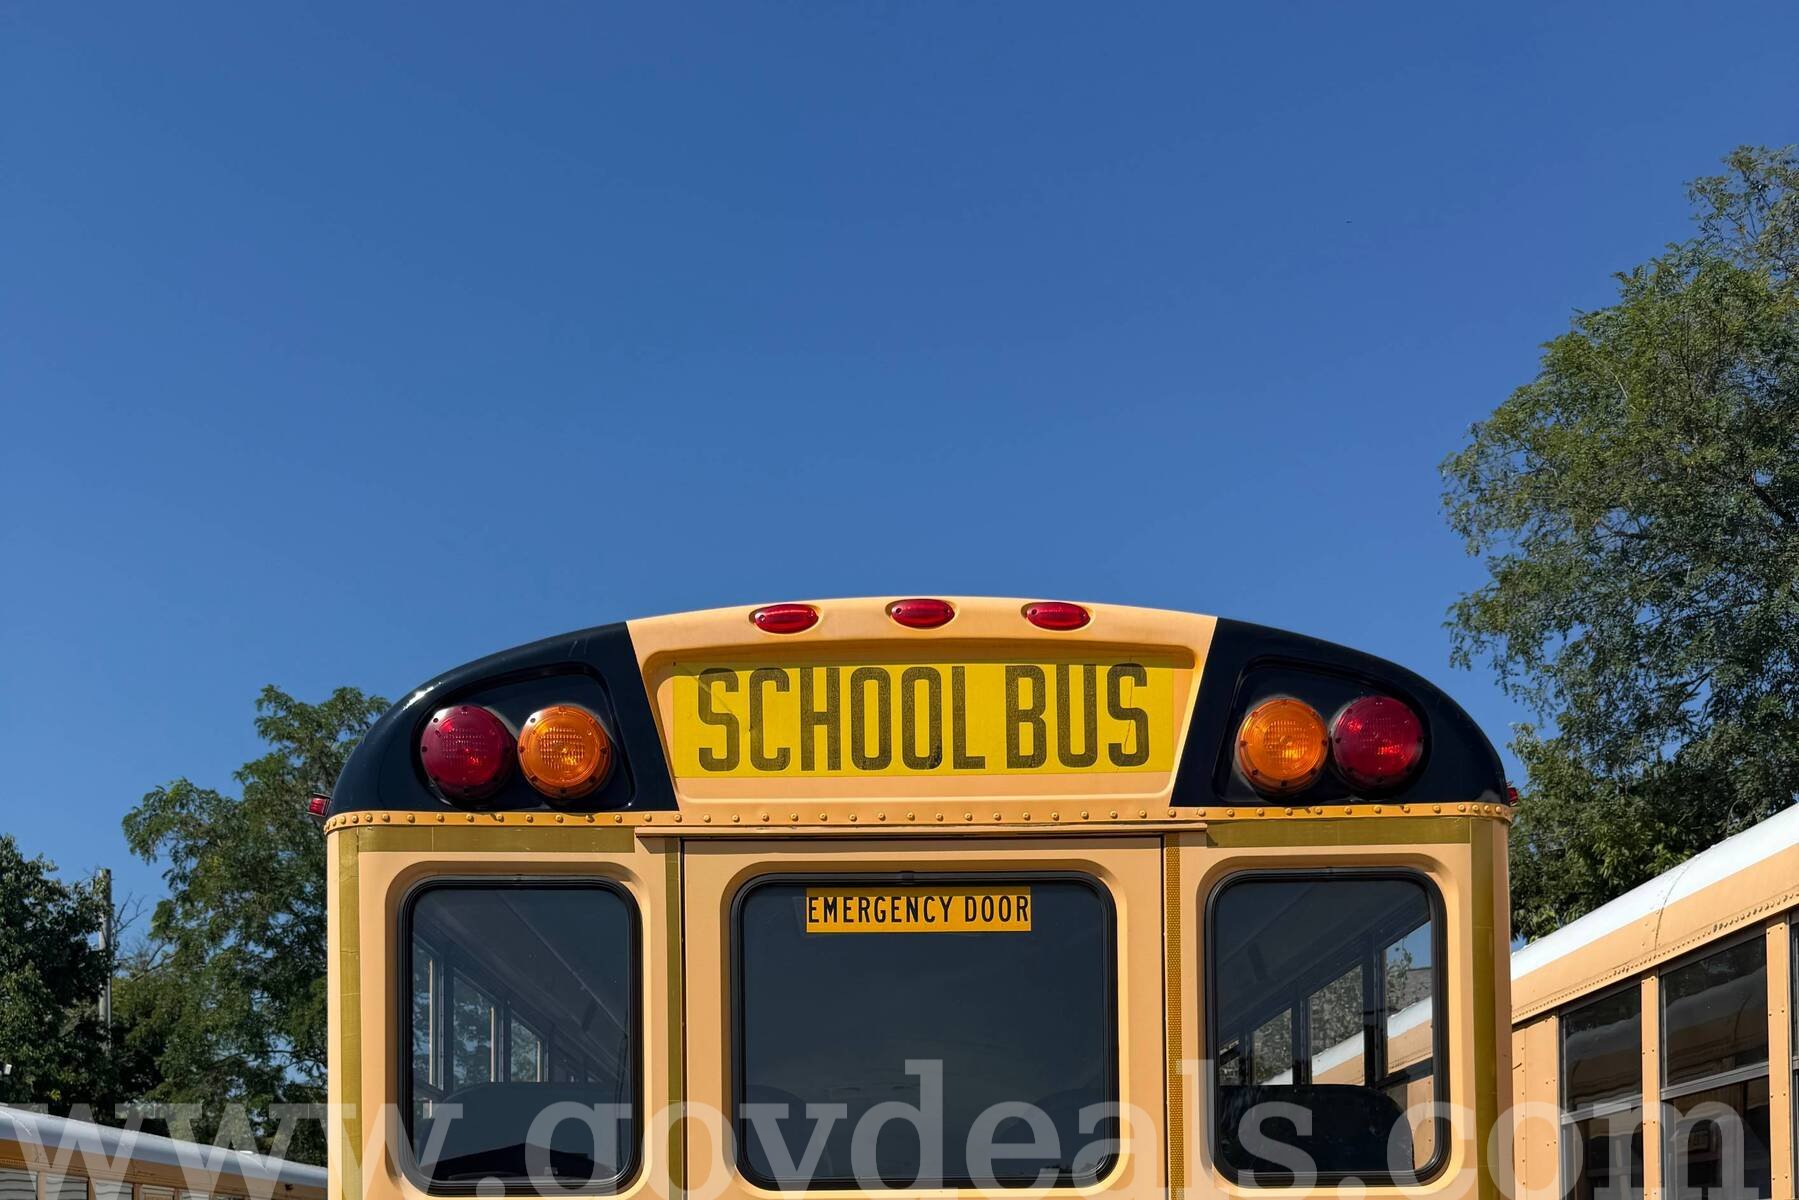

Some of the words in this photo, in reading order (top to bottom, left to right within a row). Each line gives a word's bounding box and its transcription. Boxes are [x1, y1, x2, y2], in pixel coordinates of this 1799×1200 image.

[698, 666, 986, 772] SCHOOL
[1006, 663, 1149, 769] BUS
[808, 895, 953, 924] EMERGENCY
[965, 895, 1029, 922] DOOR
